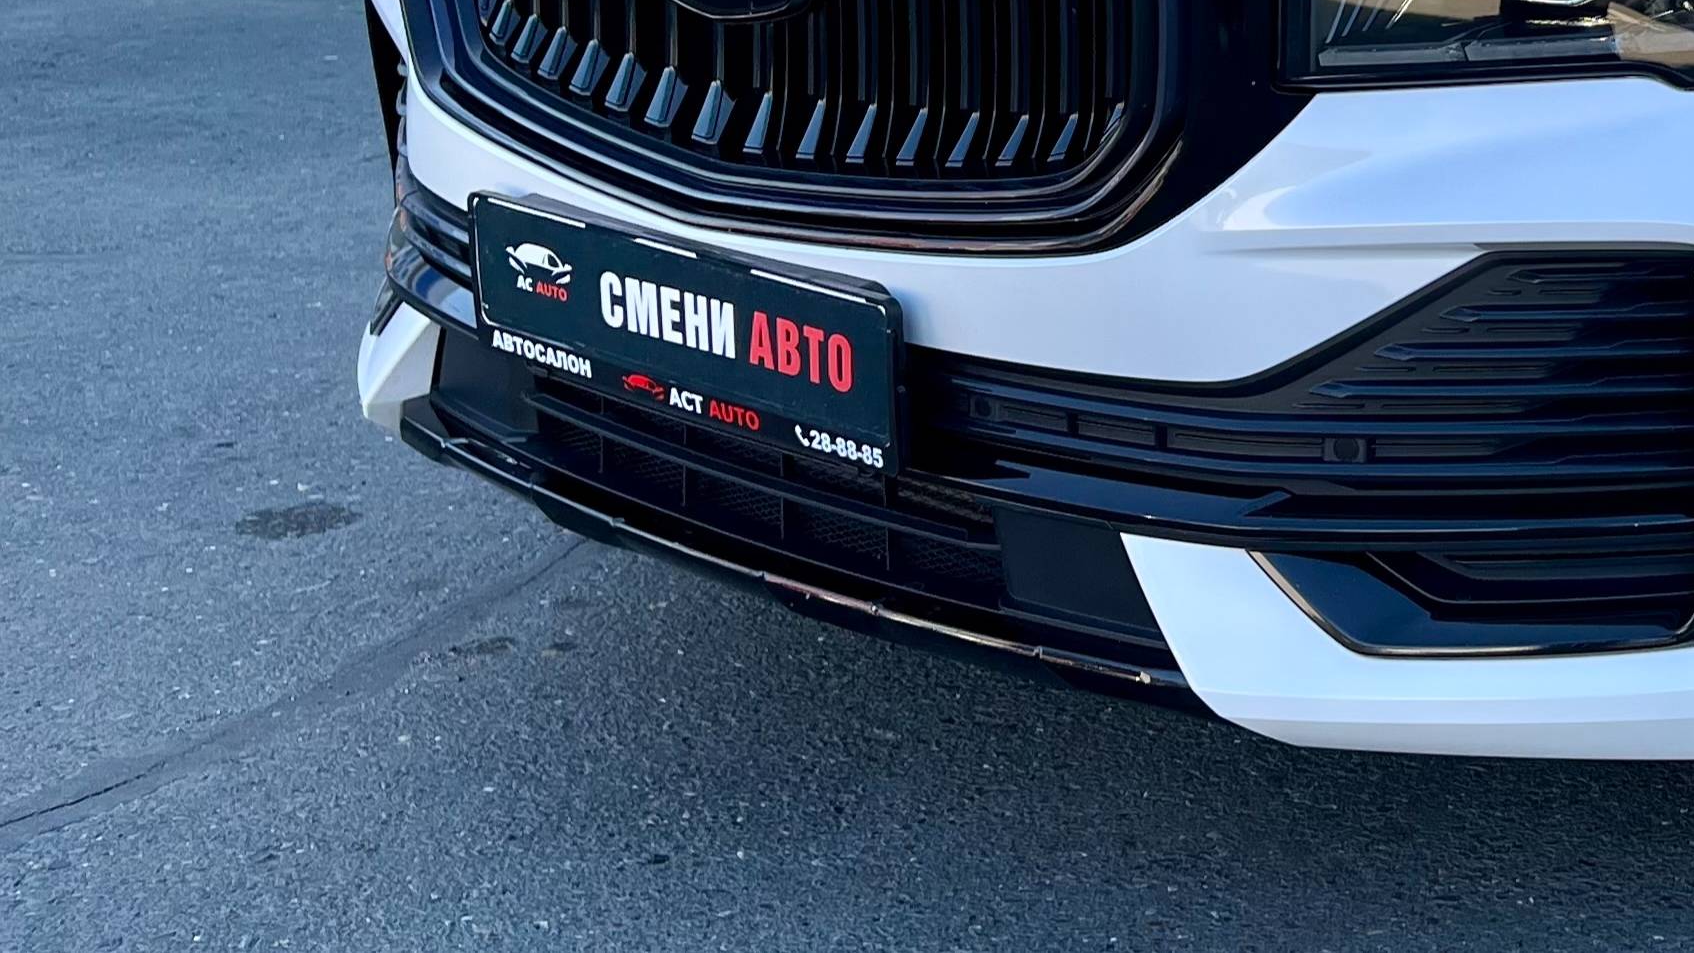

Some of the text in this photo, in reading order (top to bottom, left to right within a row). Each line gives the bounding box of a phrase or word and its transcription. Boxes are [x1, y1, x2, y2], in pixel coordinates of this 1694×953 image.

[536, 281, 568, 302] AUTO
[600, 270, 854, 393] СМЕНИ АВТО
[491, 329, 593, 379] АВТОСАЛОН
[709, 399, 760, 431] AUTO
[808, 429, 884, 469] 28-88-85
